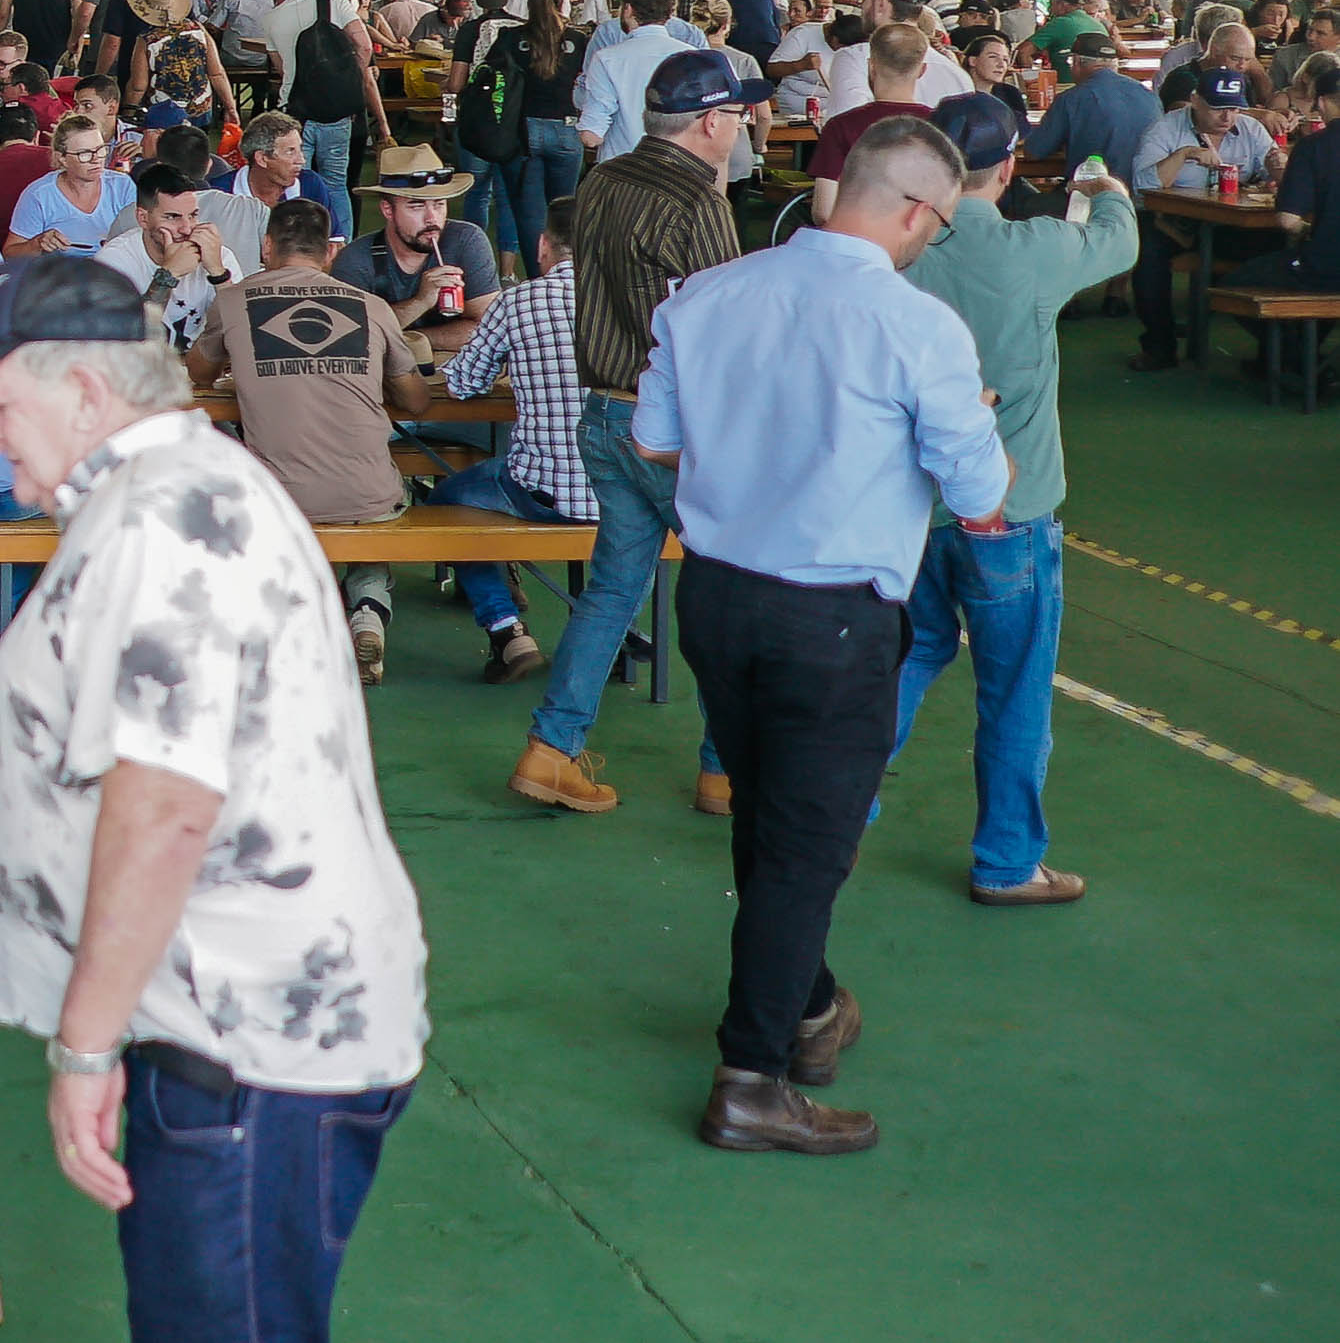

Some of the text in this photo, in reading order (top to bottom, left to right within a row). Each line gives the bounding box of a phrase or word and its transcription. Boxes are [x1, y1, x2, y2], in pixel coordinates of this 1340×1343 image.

[1216, 79, 1242, 93] LS
[245, 287, 275, 298] BRAZIL
[278, 286, 308, 296] ABOVE
[256, 360, 369, 377] GOD ABOVE EVERYONE
